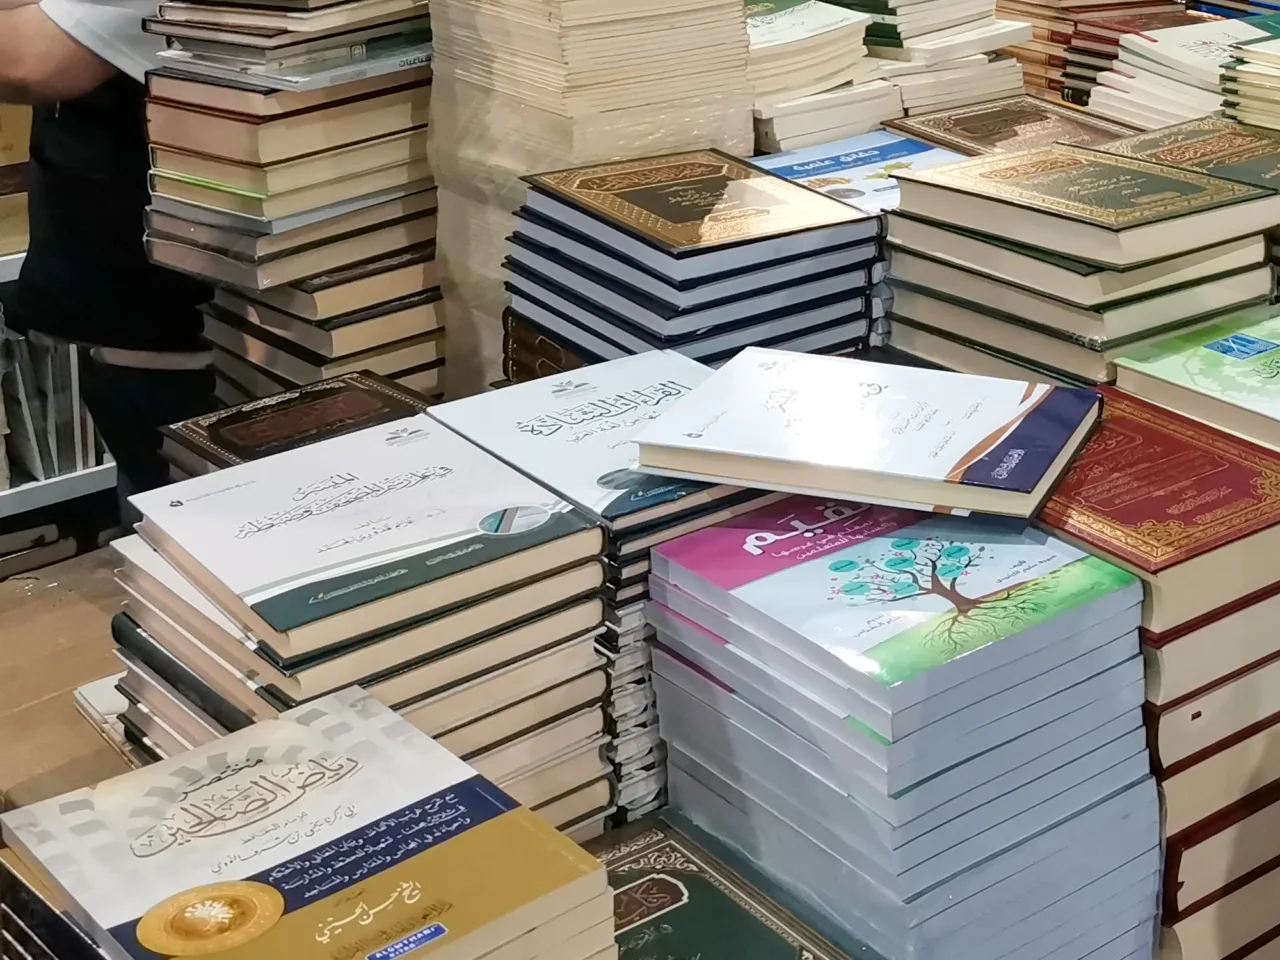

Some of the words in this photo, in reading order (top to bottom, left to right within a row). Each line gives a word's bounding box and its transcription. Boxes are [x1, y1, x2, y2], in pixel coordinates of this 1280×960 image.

[792, 158, 836, 171] علمية
[840, 150, 881, 162] حقائق
[603, 380, 693, 419] القراءات
[179, 757, 264, 802] مختصر
[129, 774, 291, 858] الصالحين
[425, 797, 444, 813] شرح
